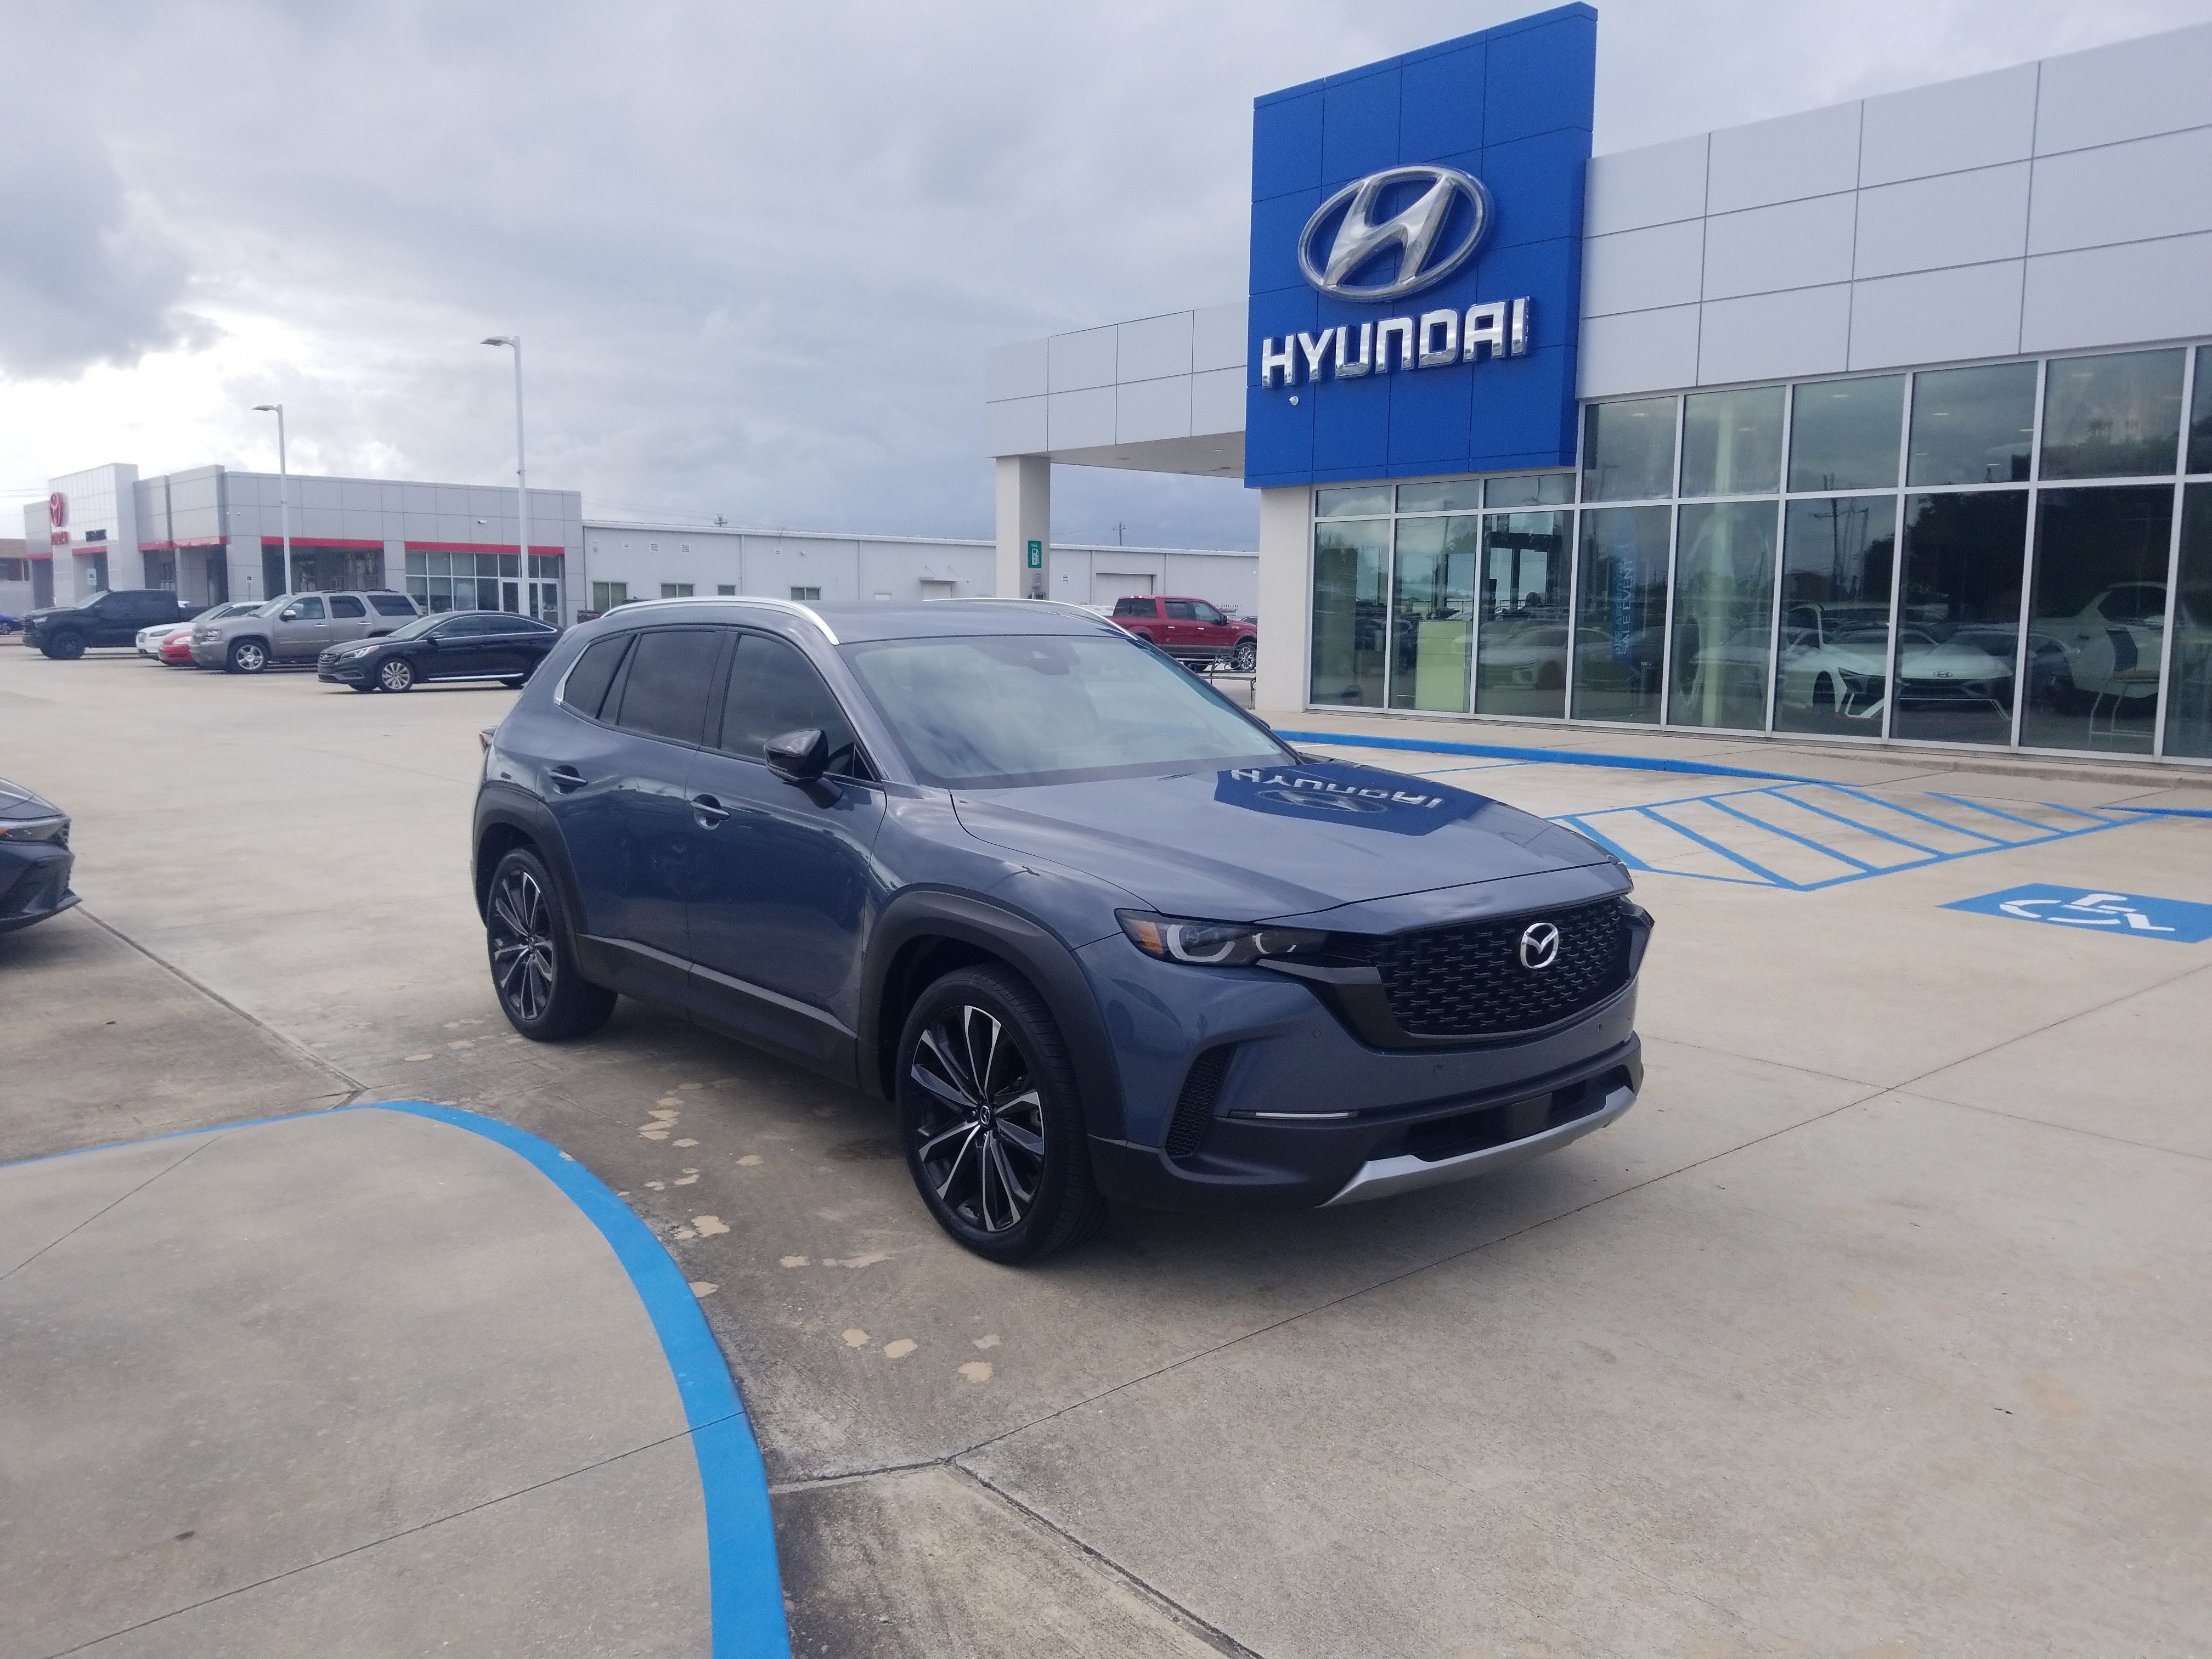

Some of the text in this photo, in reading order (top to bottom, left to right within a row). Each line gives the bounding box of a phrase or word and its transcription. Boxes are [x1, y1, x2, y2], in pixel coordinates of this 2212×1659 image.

[1262, 296, 1530, 388] HYUNDAI
[1622, 558, 1633, 654] SALE EVENT
